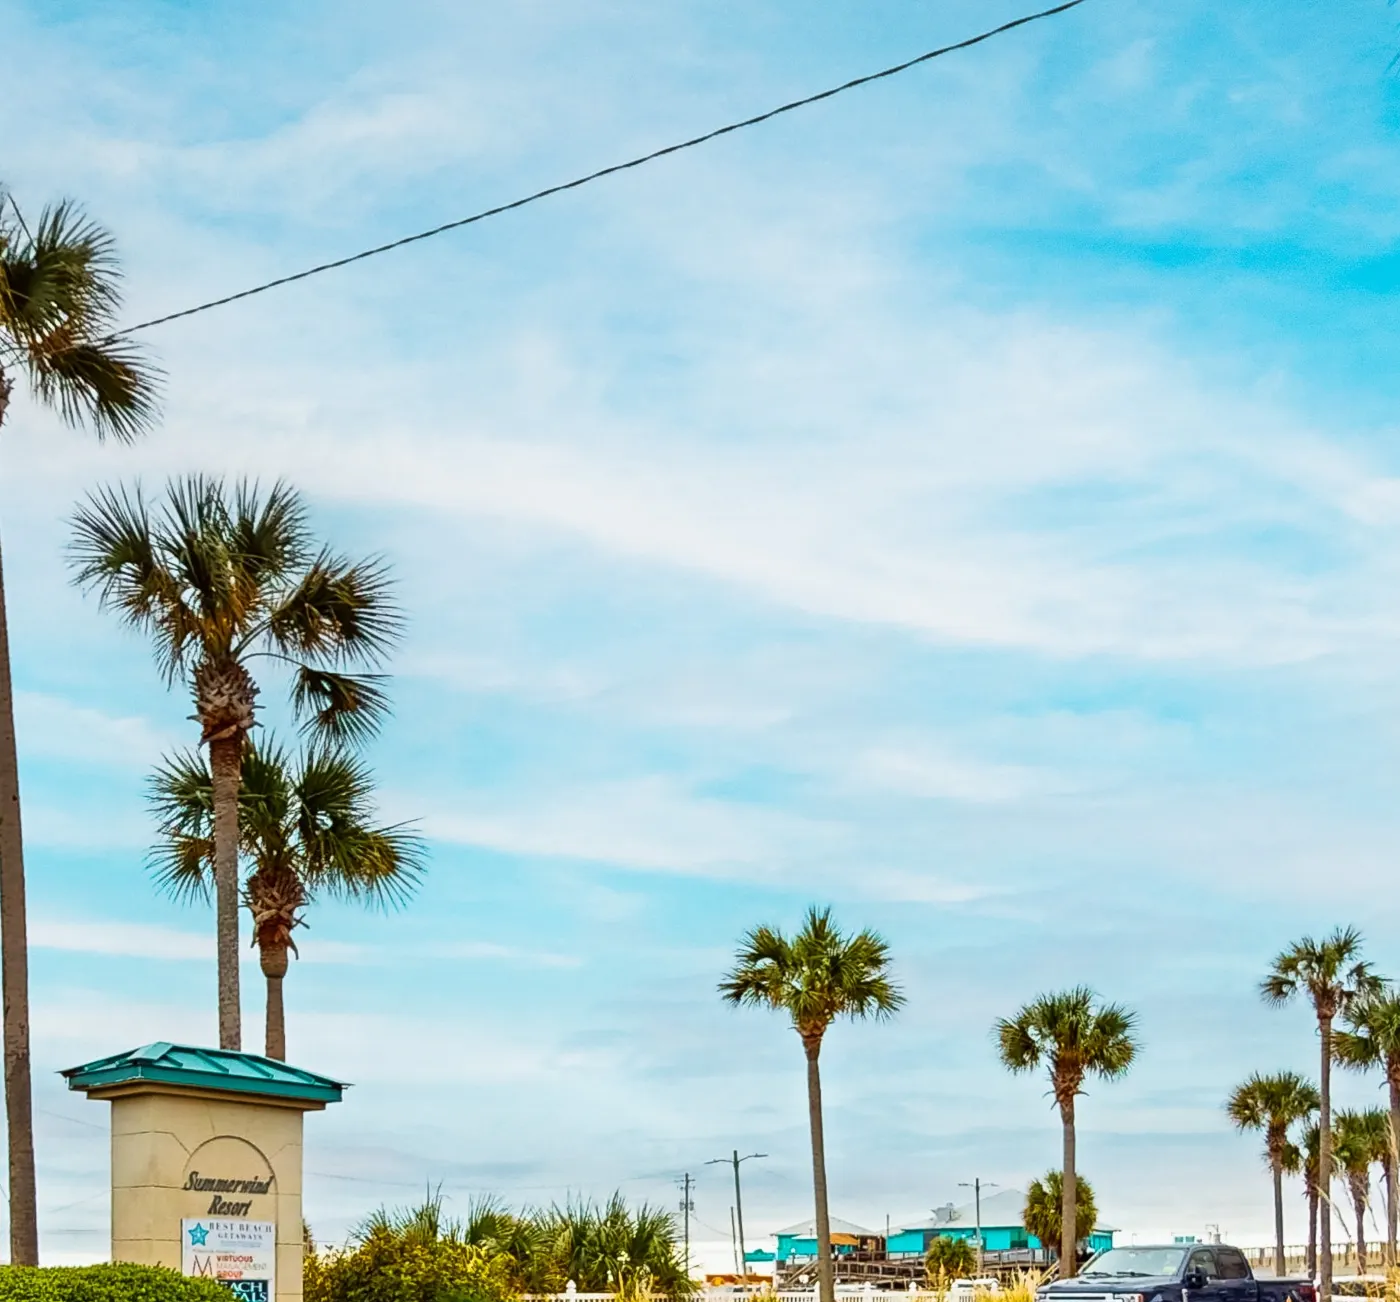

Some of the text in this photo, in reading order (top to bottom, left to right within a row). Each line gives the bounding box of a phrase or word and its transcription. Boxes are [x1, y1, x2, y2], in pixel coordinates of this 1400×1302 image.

[182, 1171, 274, 1194] Summerwind
[208, 1195, 252, 1216] Resort
[209, 1222, 272, 1232] BEST BEACH
[217, 1255, 253, 1263] VIRTUOUS
